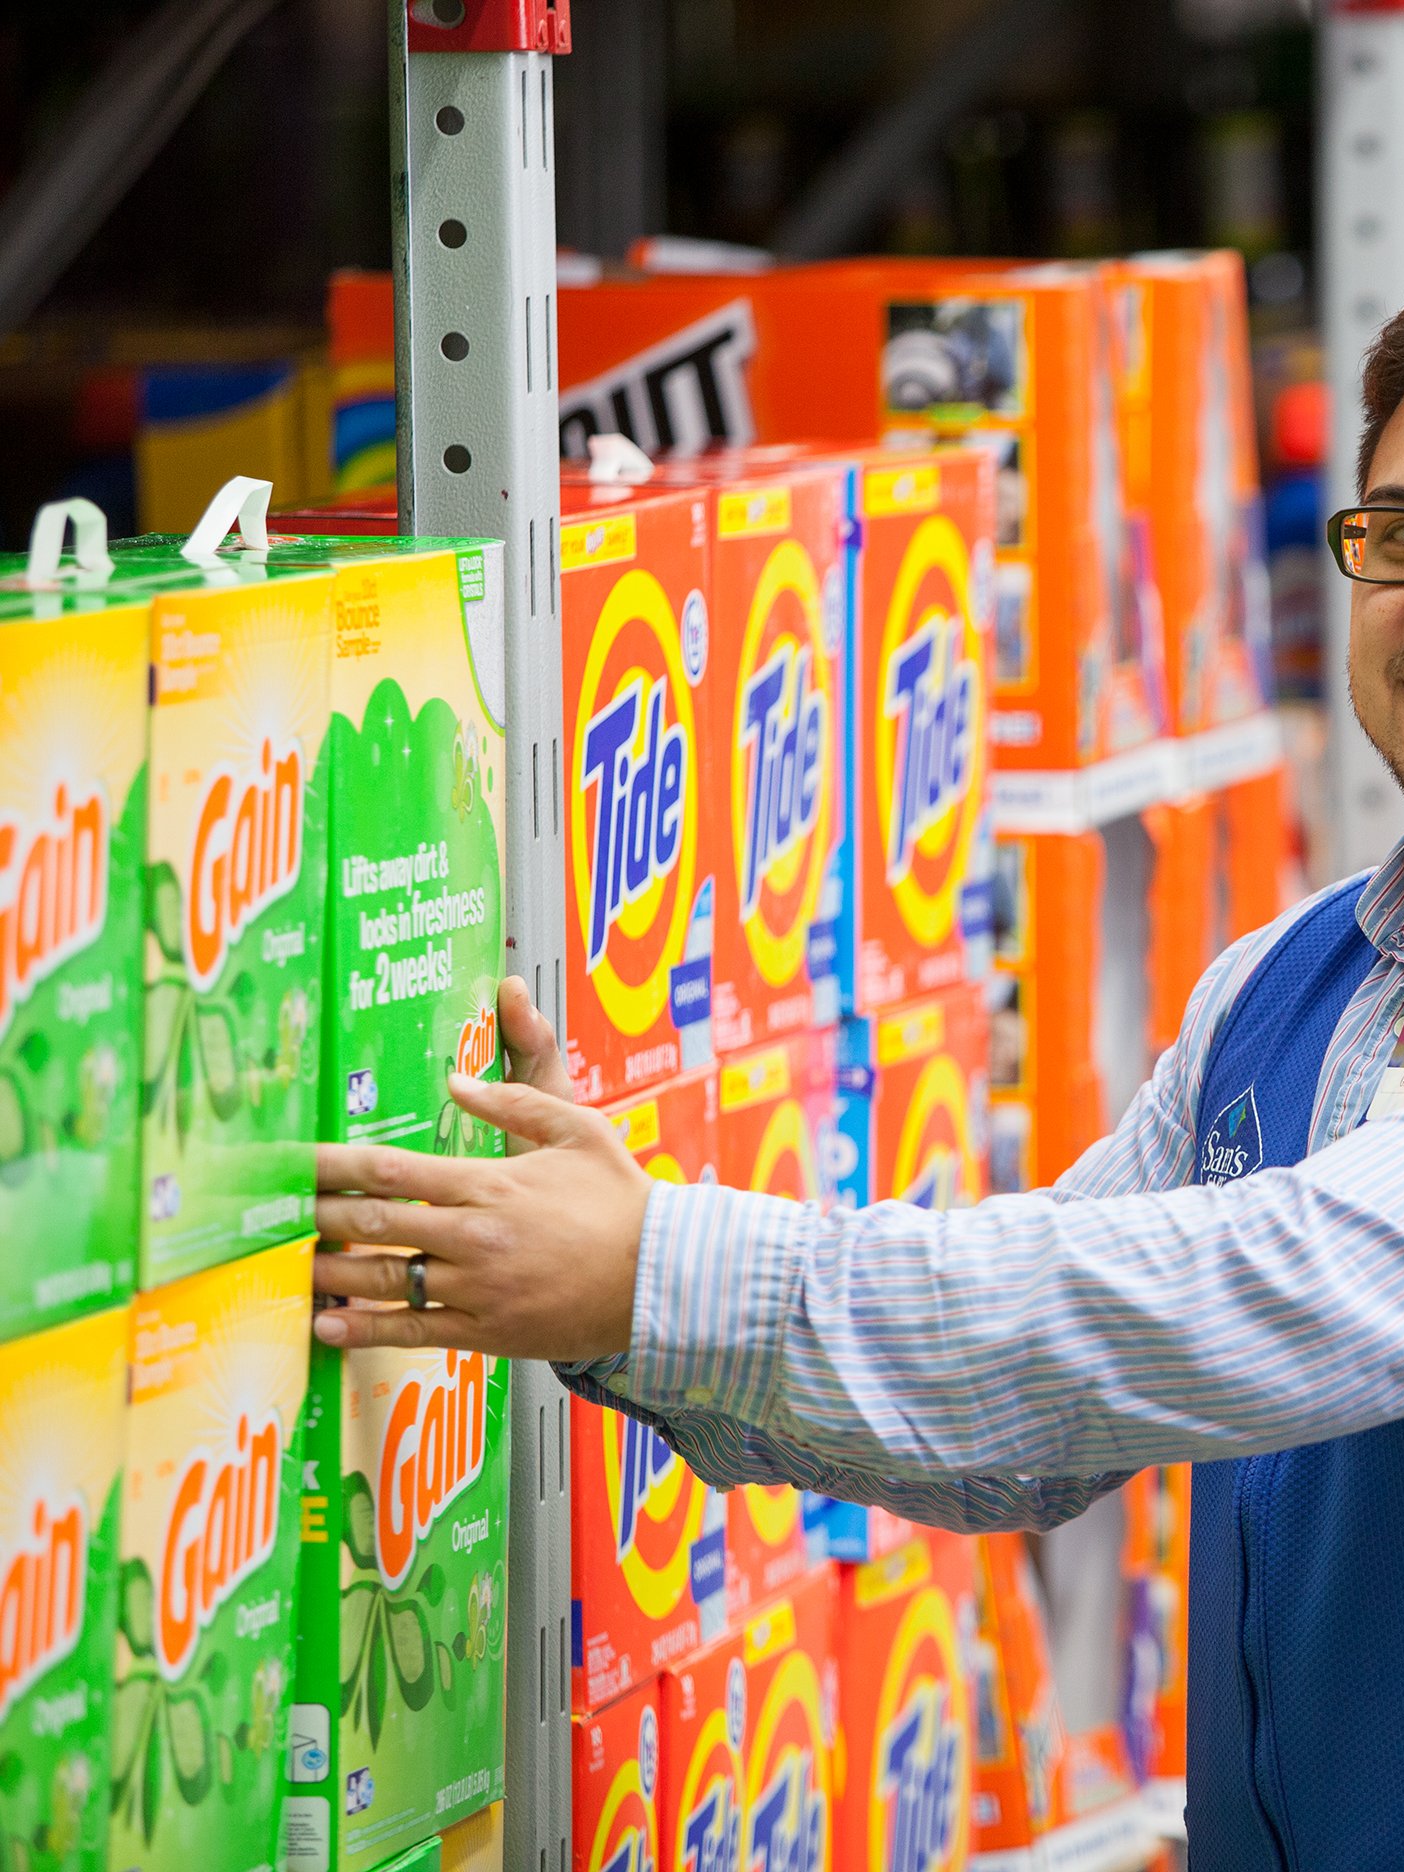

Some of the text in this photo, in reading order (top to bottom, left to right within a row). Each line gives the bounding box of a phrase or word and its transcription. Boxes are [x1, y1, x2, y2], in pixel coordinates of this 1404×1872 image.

[189, 736, 300, 977] Gain
[583, 680, 685, 968] Tide
[743, 648, 822, 914] Tide
[890, 622, 974, 878] Tide
[0, 782, 104, 1026] ain
[343, 841, 449, 898] Lifts away dirt &
[351, 937, 453, 1011] for 2 weeks!
[360, 885, 485, 950] locks in freshness
[160, 1412, 278, 1666] Gain
[377, 1347, 485, 1579] Gain
[452, 1508, 489, 1555] Original
[0, 1498, 82, 1712] ain
